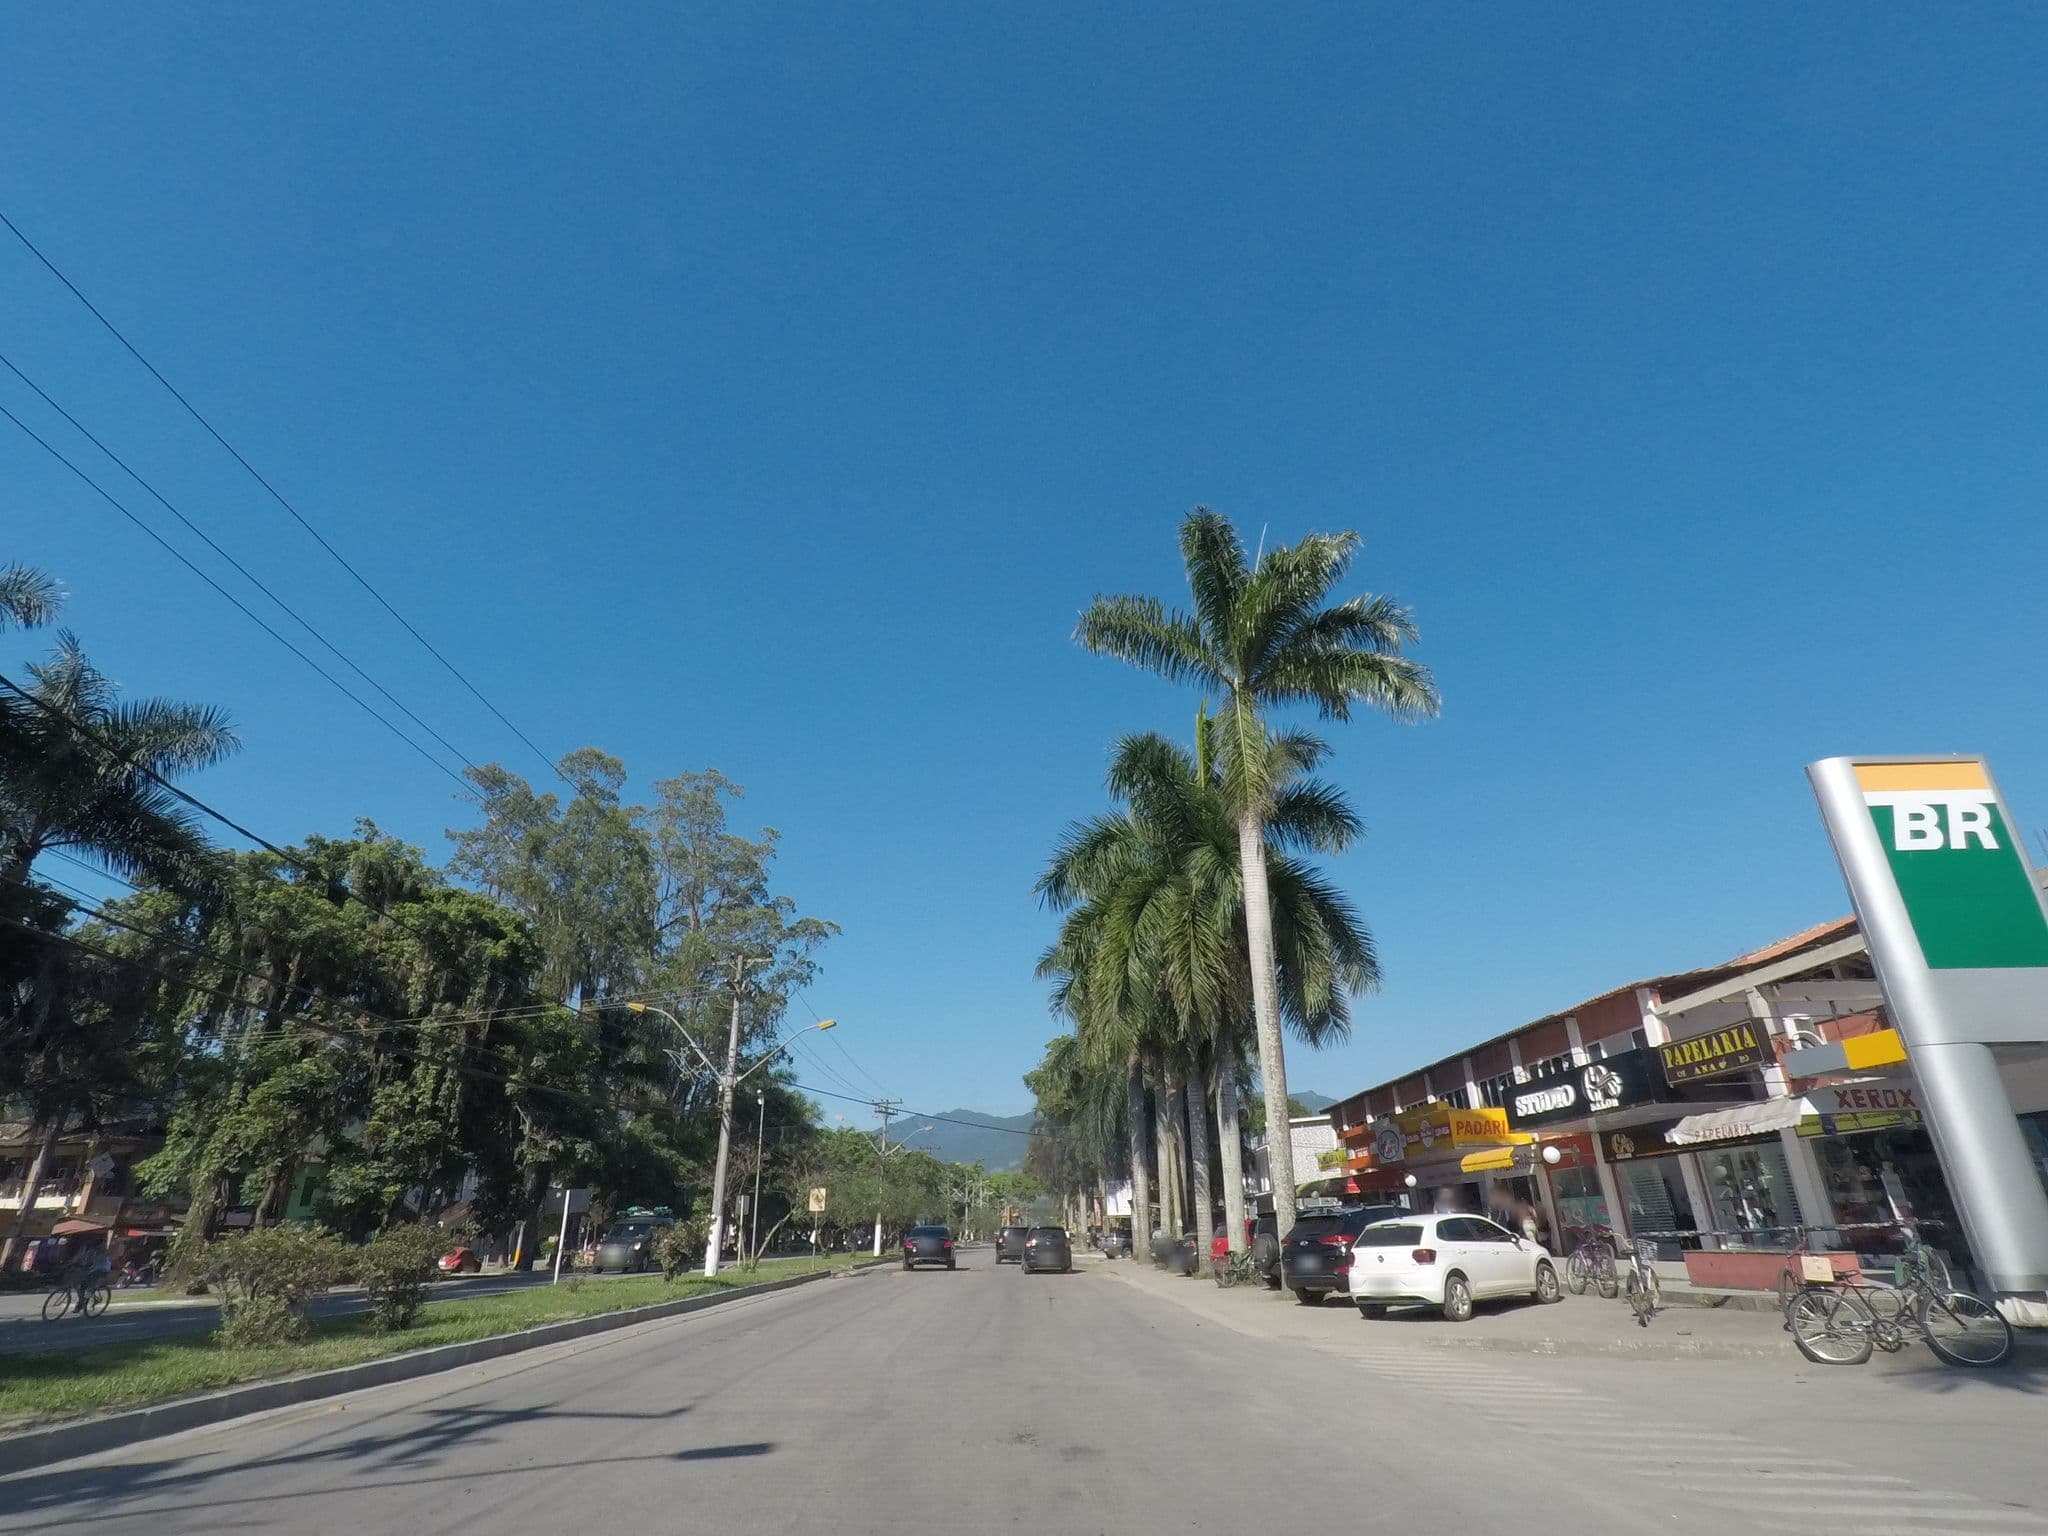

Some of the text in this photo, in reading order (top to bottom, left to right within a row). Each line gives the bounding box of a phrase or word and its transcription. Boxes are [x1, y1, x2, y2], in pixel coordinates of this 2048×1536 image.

[1893, 803, 1999, 851] BR
[1663, 1025, 1757, 1069] PAPELARIA
[1834, 1088, 1917, 1110] XEROX
[1694, 1122, 1752, 1141] PAPELARIA
